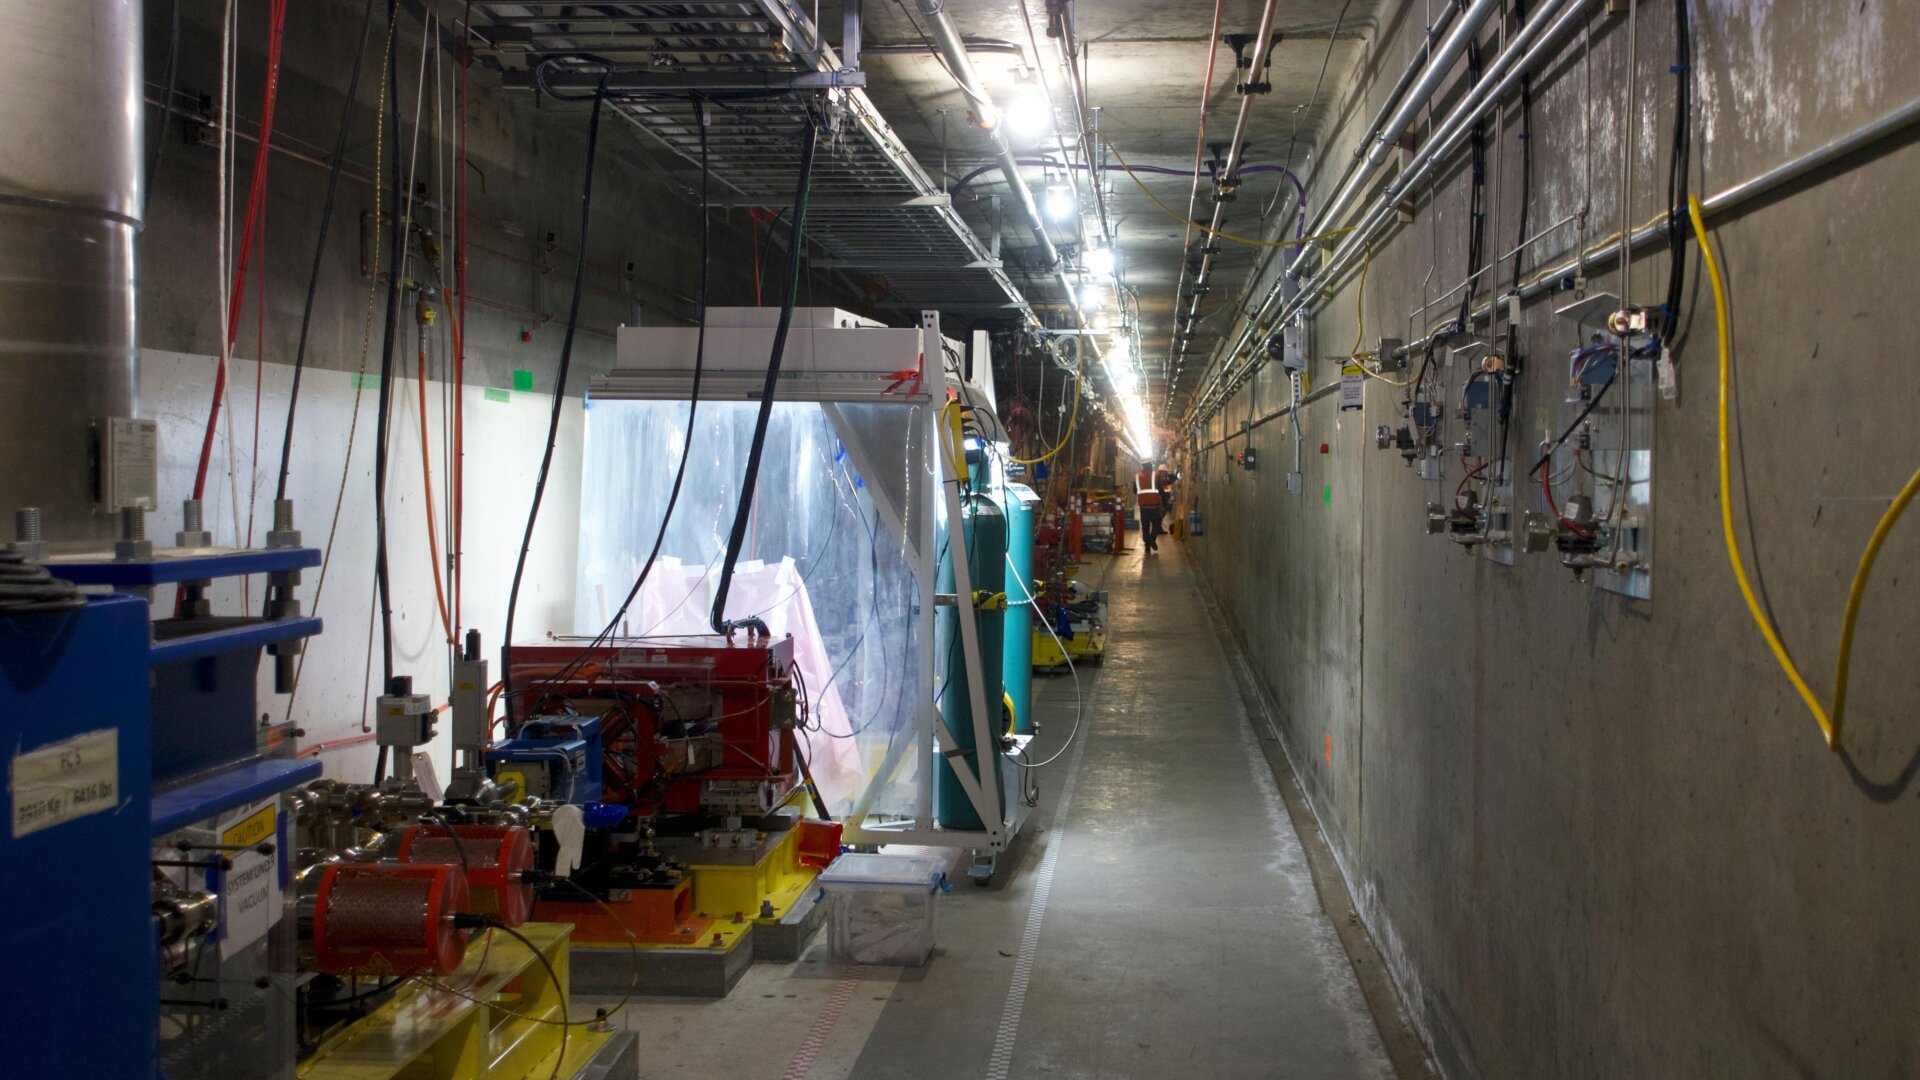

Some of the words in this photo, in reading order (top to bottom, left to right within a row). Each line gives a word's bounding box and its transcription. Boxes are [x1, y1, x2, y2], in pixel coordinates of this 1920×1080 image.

[233, 819, 265, 844] CAUTION
[227, 868, 254, 896] SYSTEM
[255, 854, 275, 879] UNDER
[239, 884, 270, 914] VACUUM
